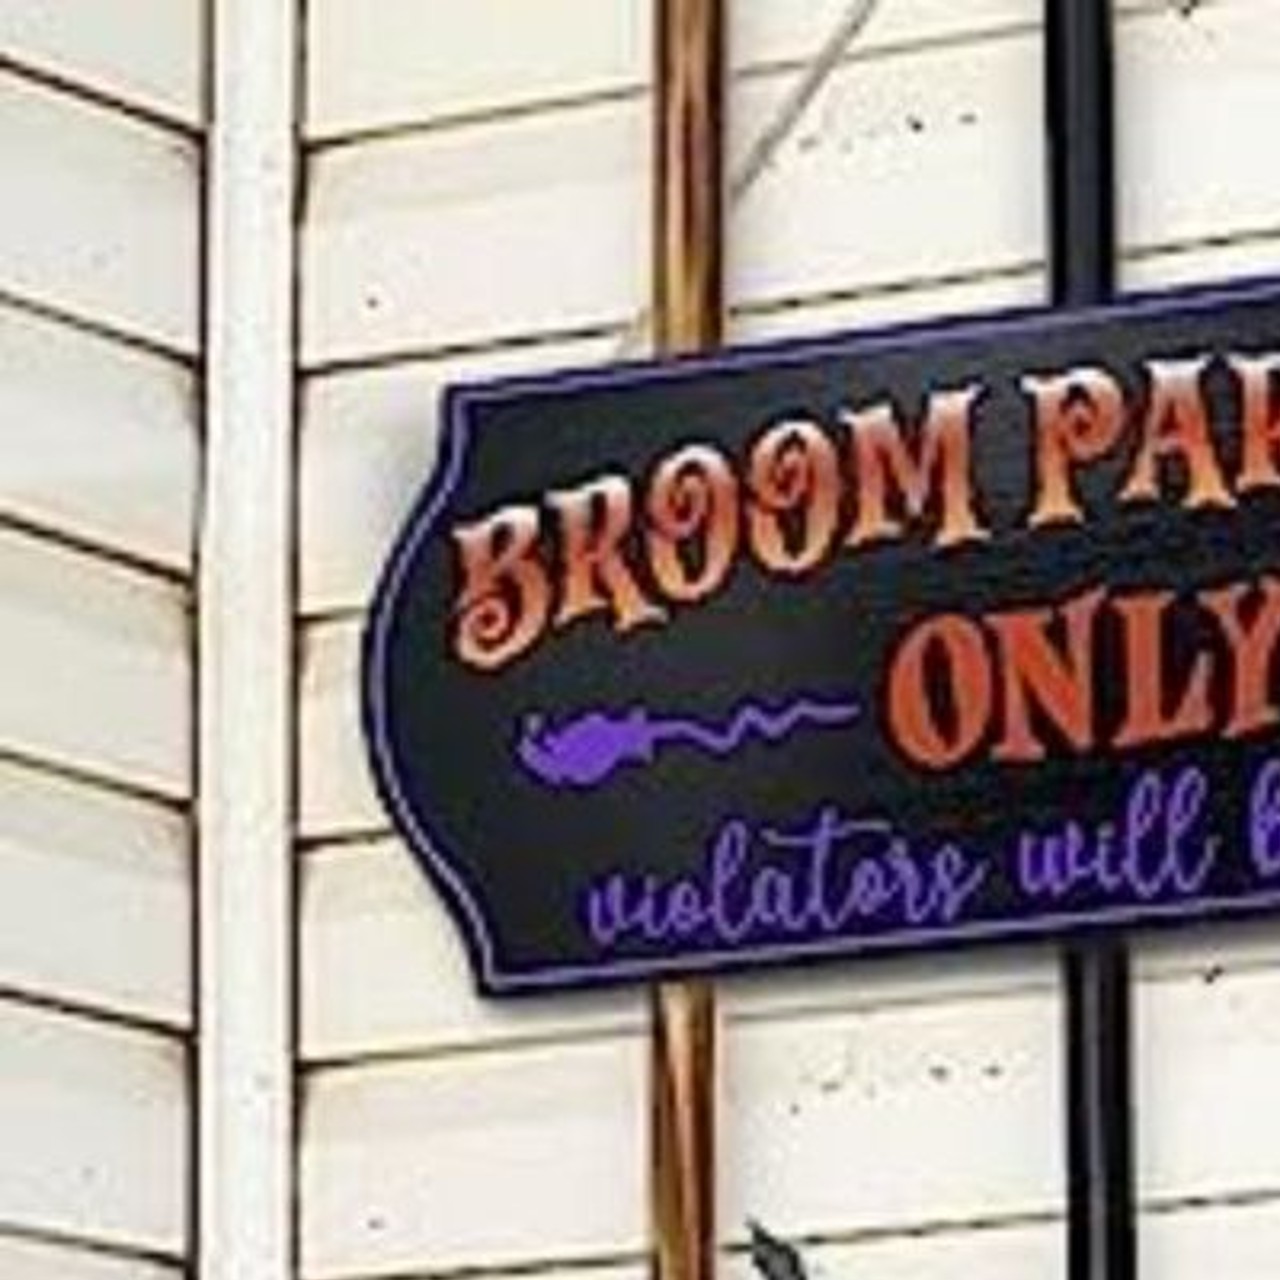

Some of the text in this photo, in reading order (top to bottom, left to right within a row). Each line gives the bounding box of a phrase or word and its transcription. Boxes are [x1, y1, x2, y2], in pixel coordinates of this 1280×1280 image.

[450, 388, 988, 671] BROOM
[587, 808, 985, 945] violators
[1018, 767, 1213, 899] will
